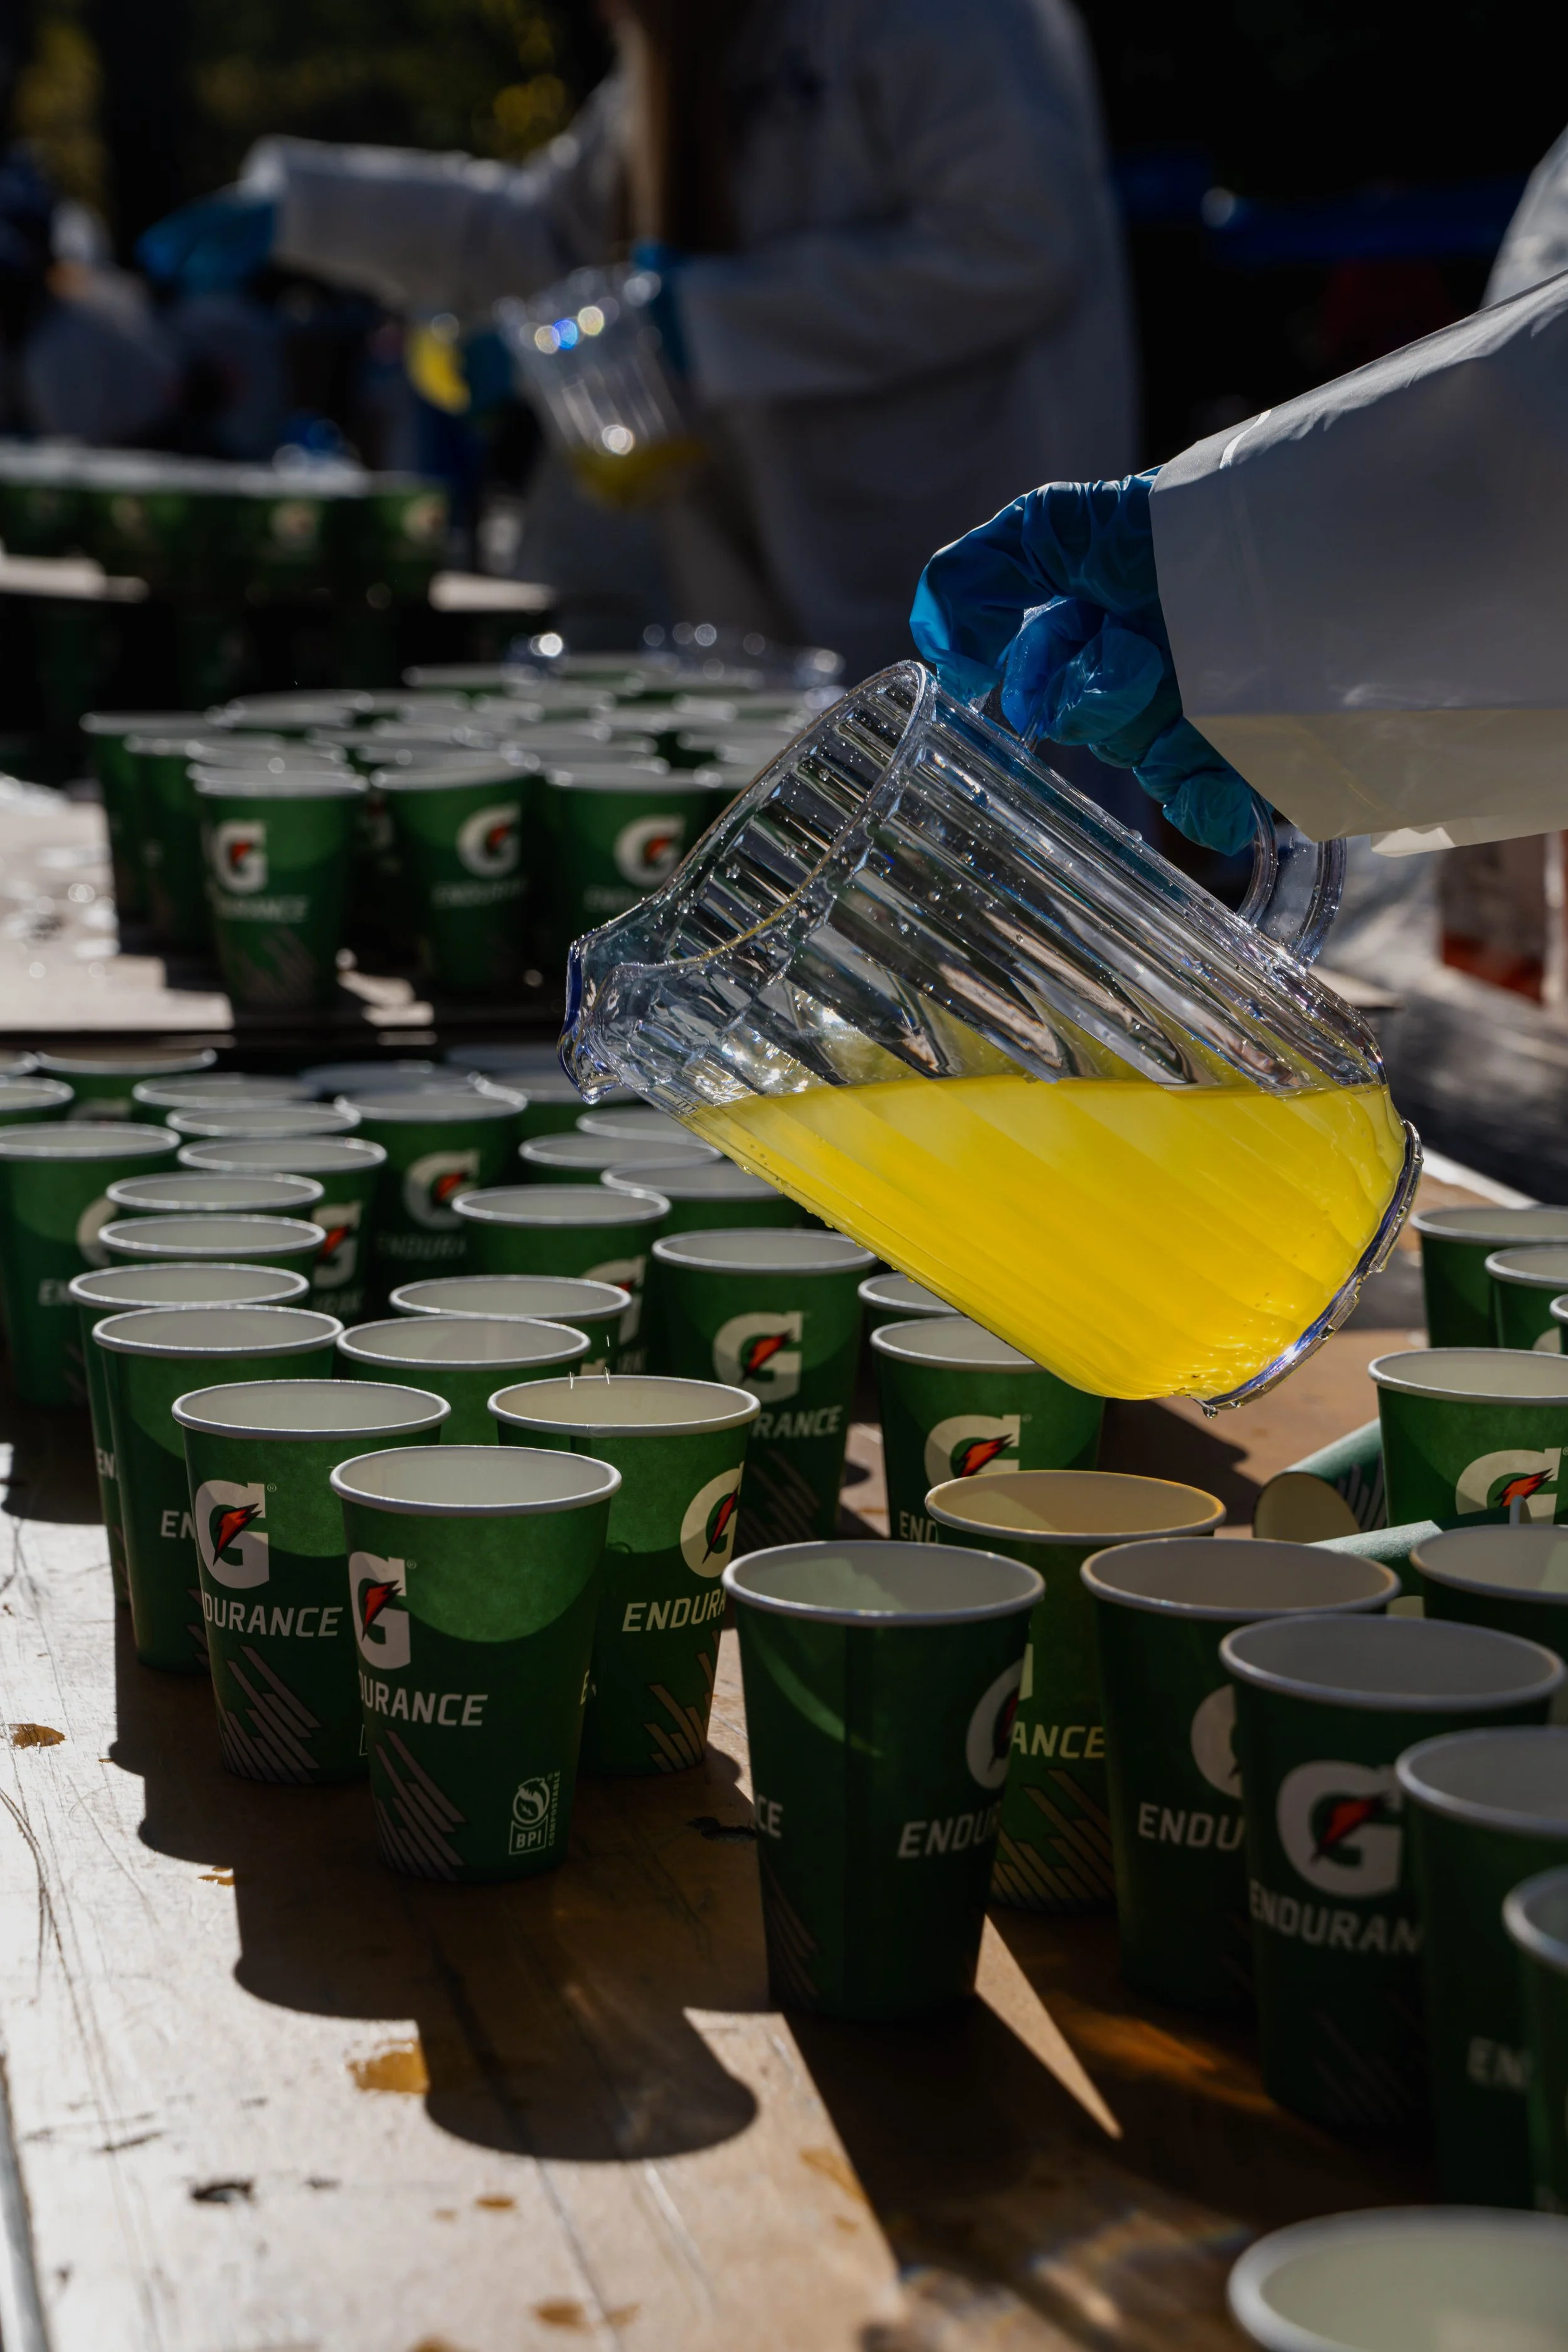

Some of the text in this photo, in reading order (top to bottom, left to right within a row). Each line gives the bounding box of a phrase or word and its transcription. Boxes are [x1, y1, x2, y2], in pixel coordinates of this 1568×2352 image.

[712, 1310, 803, 1404] G
[195, 1480, 270, 1589] G
[680, 1460, 744, 1578] G
[201, 1591, 343, 1638] DURANCE
[348, 1551, 411, 1670] G
[516, 1829, 542, 1850] BPI
[548, 1769, 561, 1847] COMPOSTABLE
[1276, 1759, 1403, 1899] G
